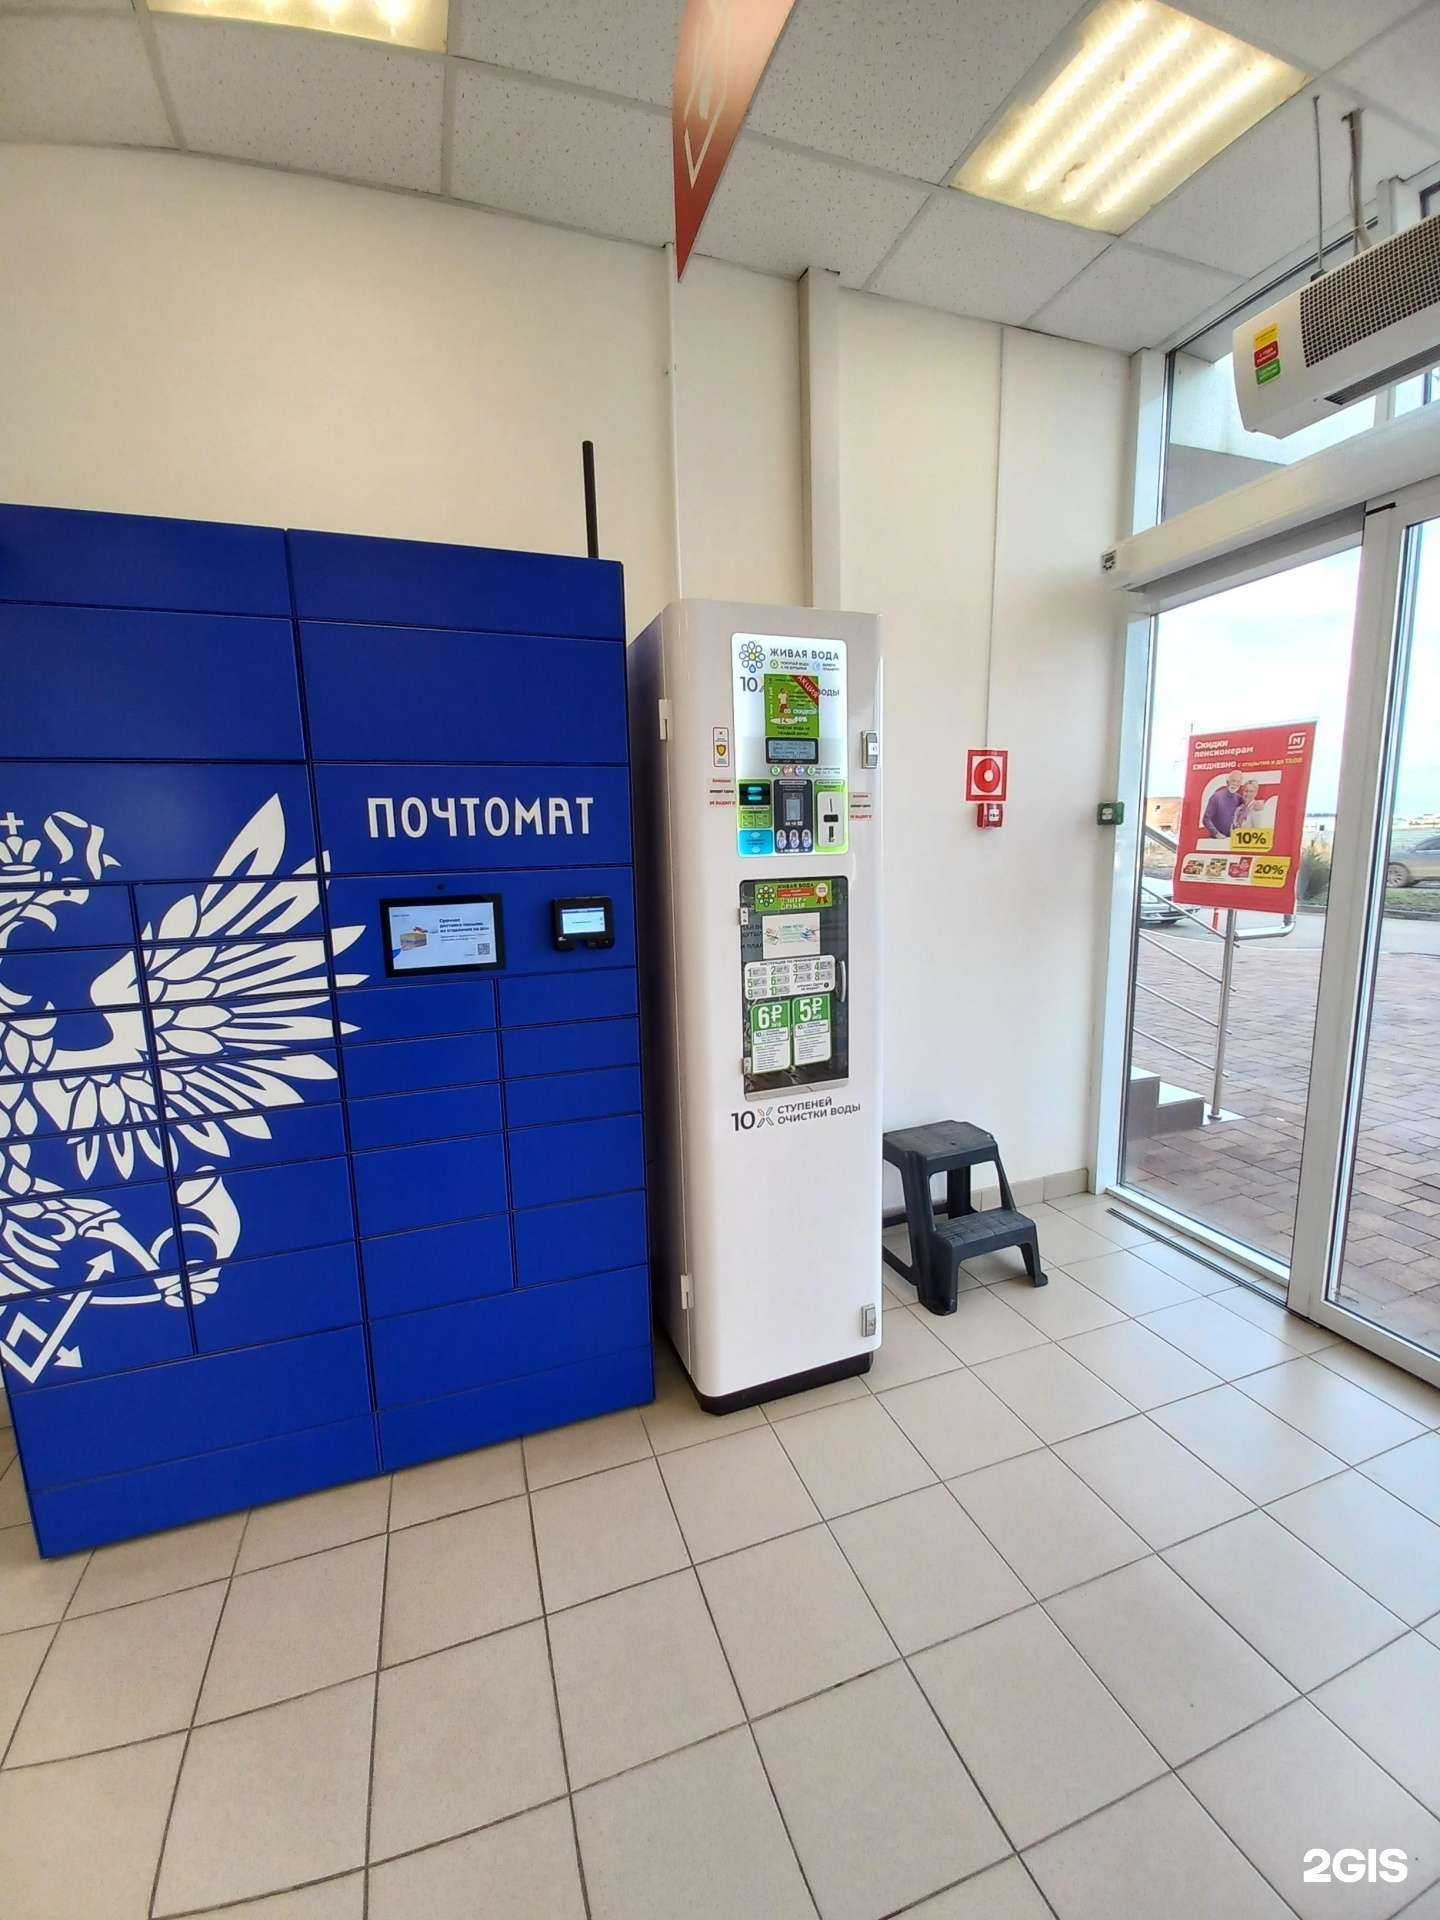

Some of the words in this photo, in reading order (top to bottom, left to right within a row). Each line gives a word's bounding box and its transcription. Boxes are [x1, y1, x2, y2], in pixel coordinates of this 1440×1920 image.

[769, 648, 808, 659] ЖИВАЯ
[811, 650, 839, 660] ВОДА
[740, 676, 758, 693] 10
[1195, 739, 1229, 750] Скидки
[1194, 746, 1255, 759] пенсионерам
[1192, 761, 1237, 771] ЕЖЕДНЕВНО
[367, 796, 594, 838] ПОЧТОМАТ
[777, 1096, 832, 1115] СТУПЕНЕЙ
[777, 1108, 828, 1125] ОЧИСТКИ
[830, 1103, 861, 1116] ВОДЫ
